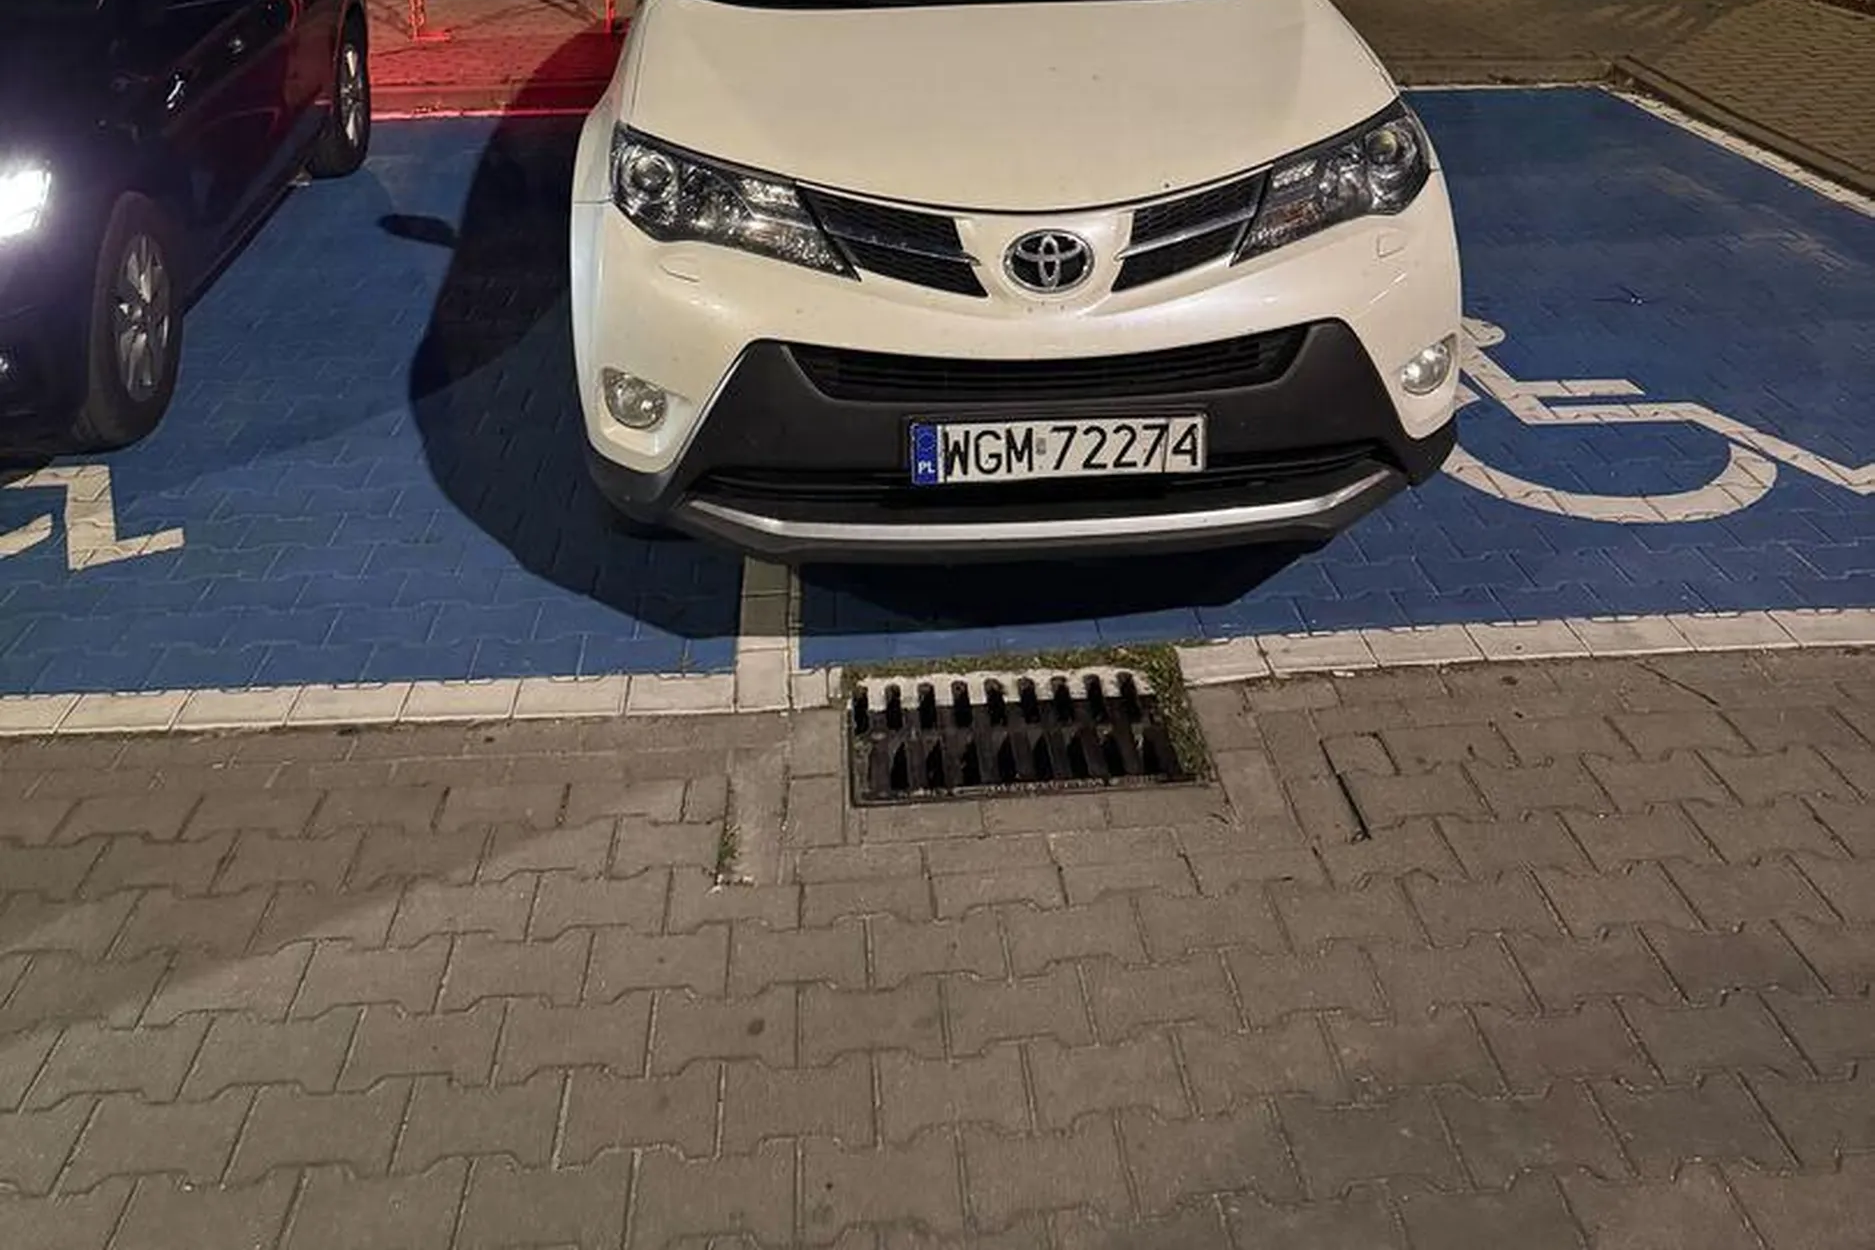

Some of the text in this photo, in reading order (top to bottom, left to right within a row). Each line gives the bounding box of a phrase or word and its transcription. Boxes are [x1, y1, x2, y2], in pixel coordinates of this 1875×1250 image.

[918, 460, 936, 474] PL
[944, 423, 1198, 477] WGM 72274
